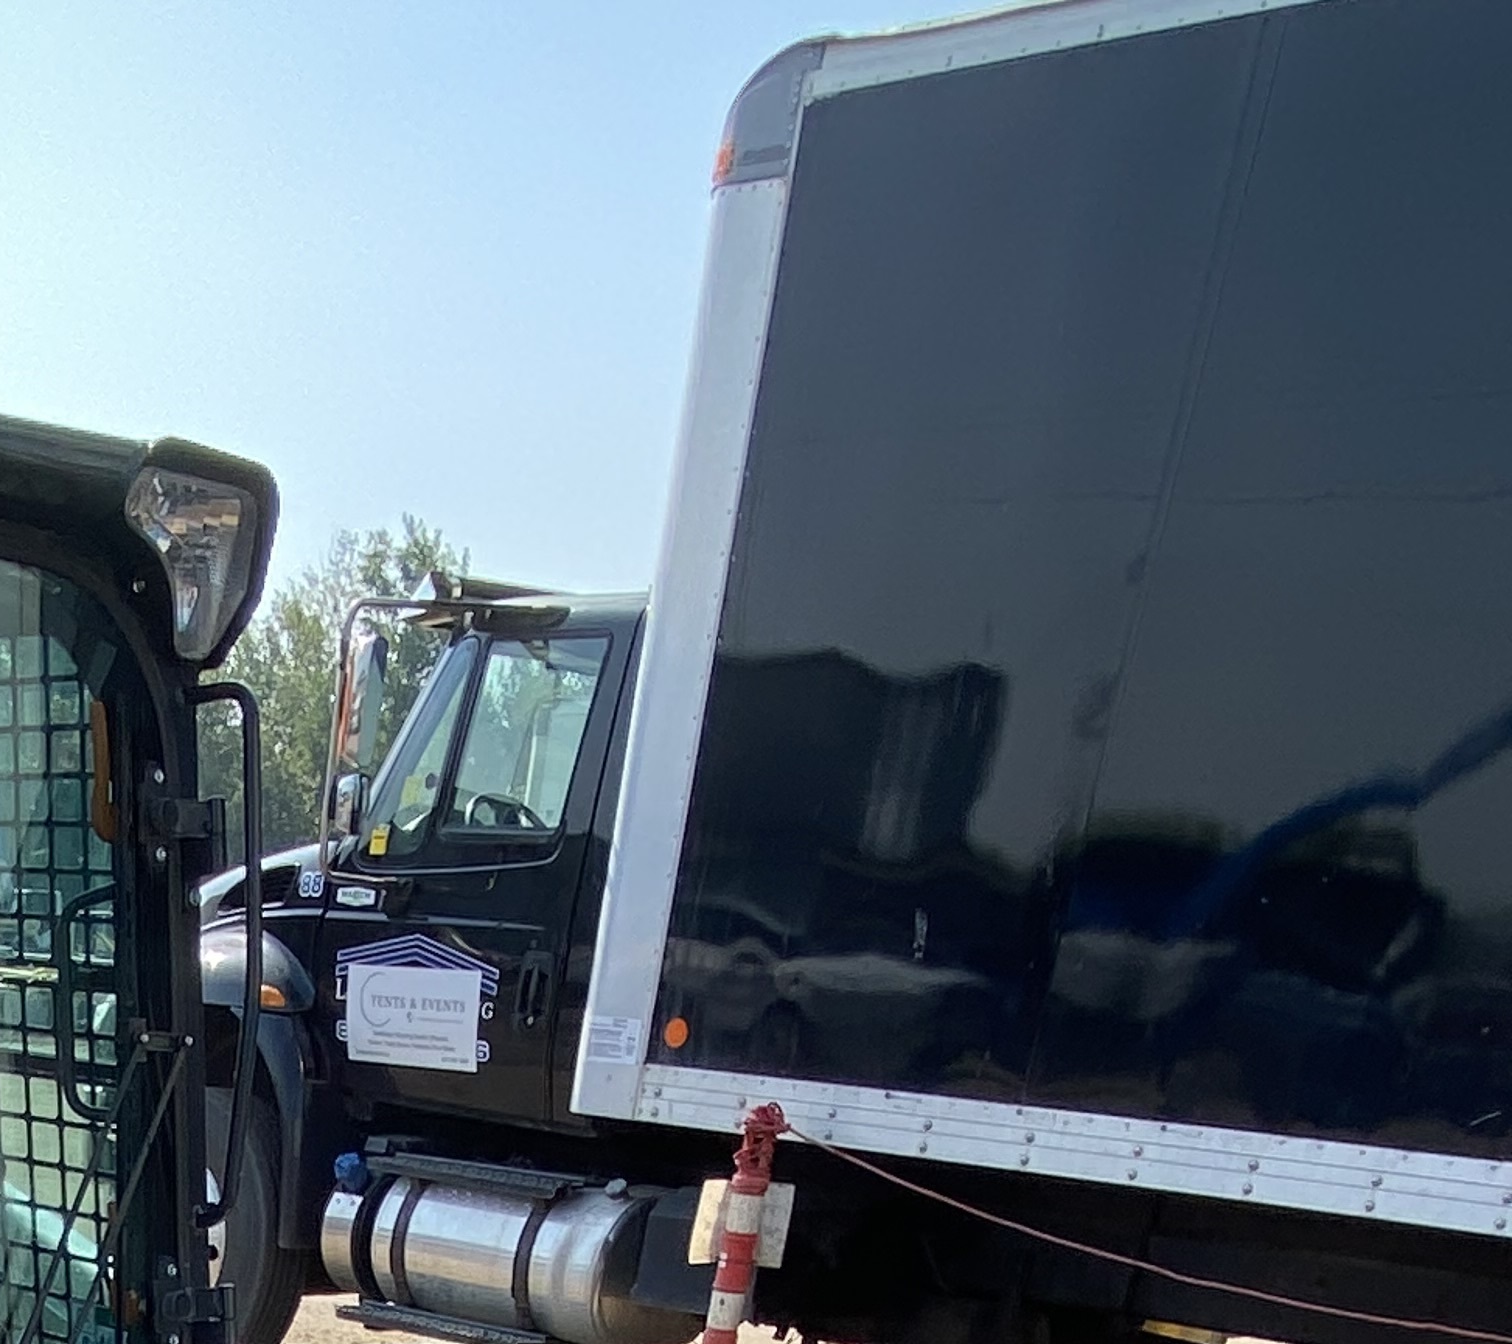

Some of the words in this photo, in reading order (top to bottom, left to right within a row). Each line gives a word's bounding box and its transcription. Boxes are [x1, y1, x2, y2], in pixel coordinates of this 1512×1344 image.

[299, 871, 324, 897] 88
[370, 994, 407, 1009] TENTS
[409, 998, 417, 1010] &
[421, 997, 466, 1013] EVENTS
